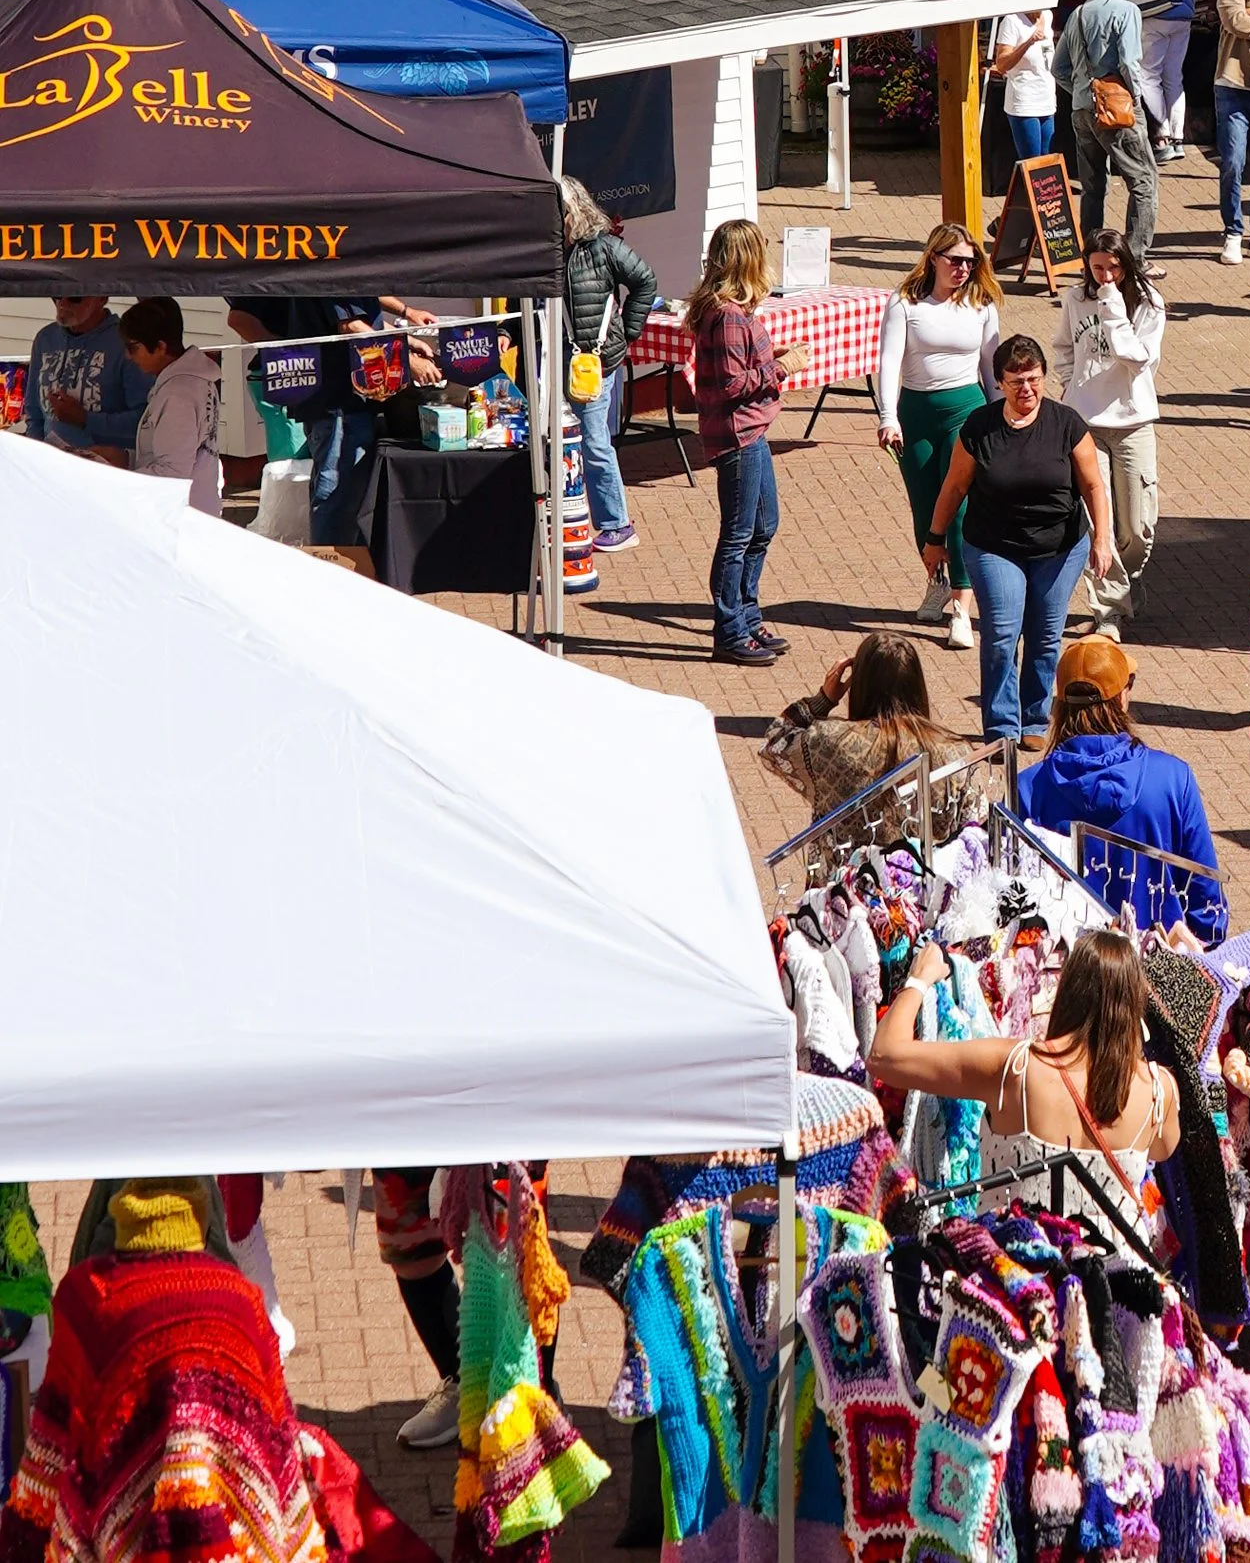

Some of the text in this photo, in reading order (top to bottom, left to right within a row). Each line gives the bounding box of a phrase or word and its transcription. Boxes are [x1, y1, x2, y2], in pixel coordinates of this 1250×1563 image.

[133, 105, 252, 133] Winery
[567, 98, 598, 123] LEY
[597, 183, 650, 202] ASSOCIATION
[135, 219, 349, 260] WINERY
[446, 337, 494, 353] SAMUEL
[451, 347, 490, 360] ADAMS
[266, 358, 316, 376] DRINK
[267, 375, 317, 392] LEGEND
